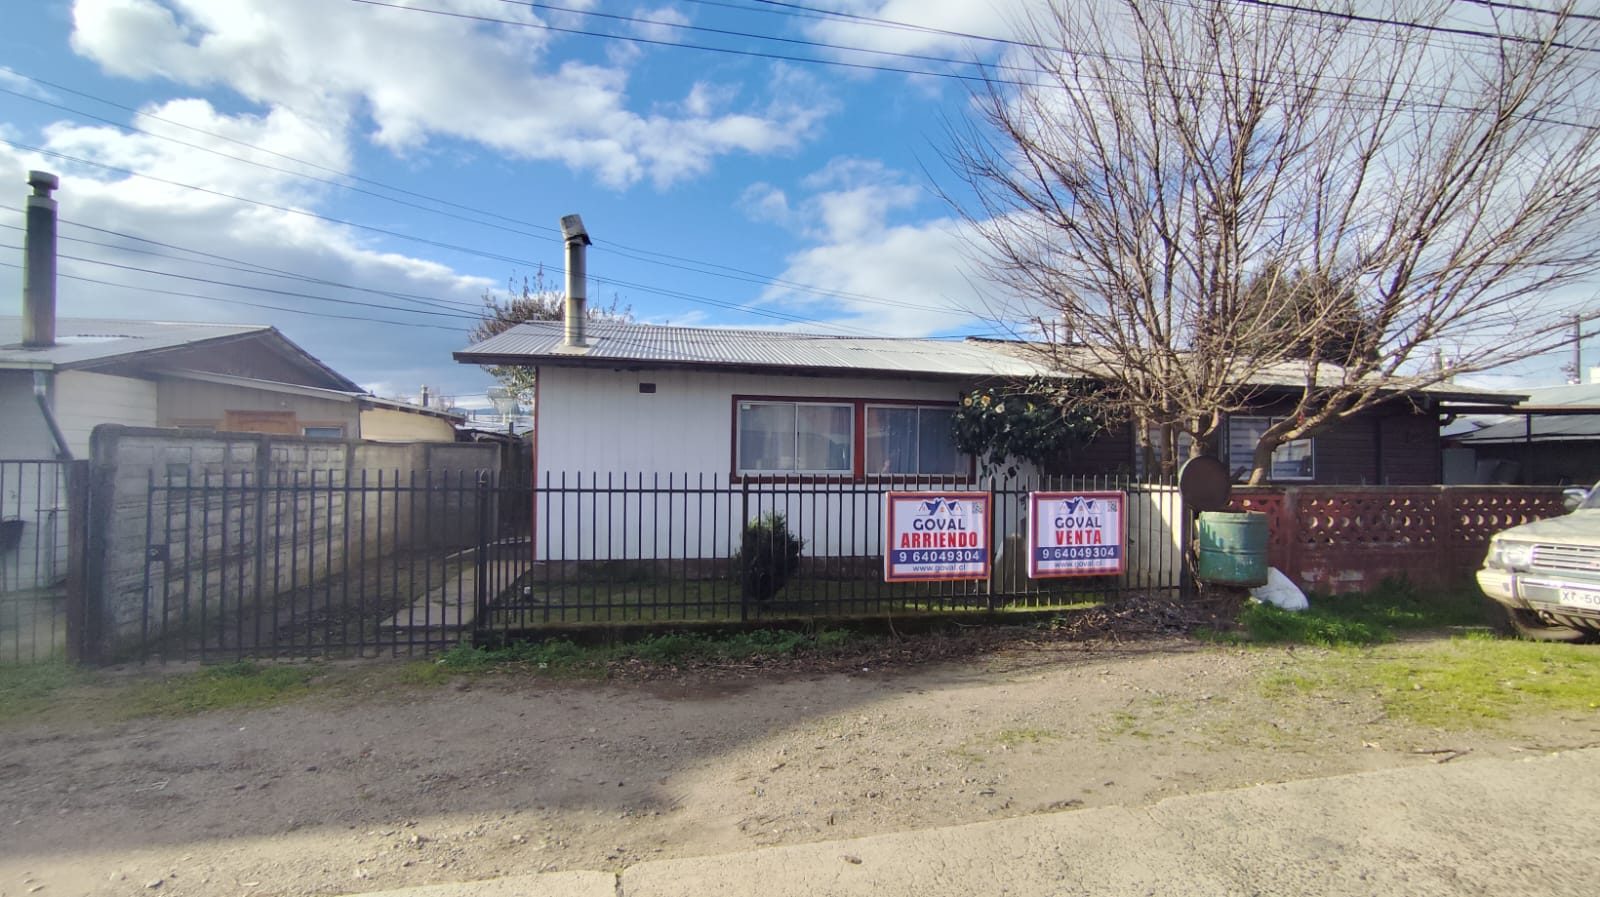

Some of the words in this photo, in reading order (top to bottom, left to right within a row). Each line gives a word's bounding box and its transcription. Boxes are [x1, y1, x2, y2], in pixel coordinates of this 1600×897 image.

[913, 518, 965, 530] GOVAL
[1055, 517, 1102, 528] GOVAL
[901, 532, 977, 548] ARRIENDO
[1056, 530, 1102, 545] VENTA
[899, 551, 907, 562] 9
[913, 551, 979, 561] 64049304
[1042, 548, 1050, 559] 9
[1054, 547, 1114, 559] 64049304
[912, 564, 966, 573] www.goval.cl
